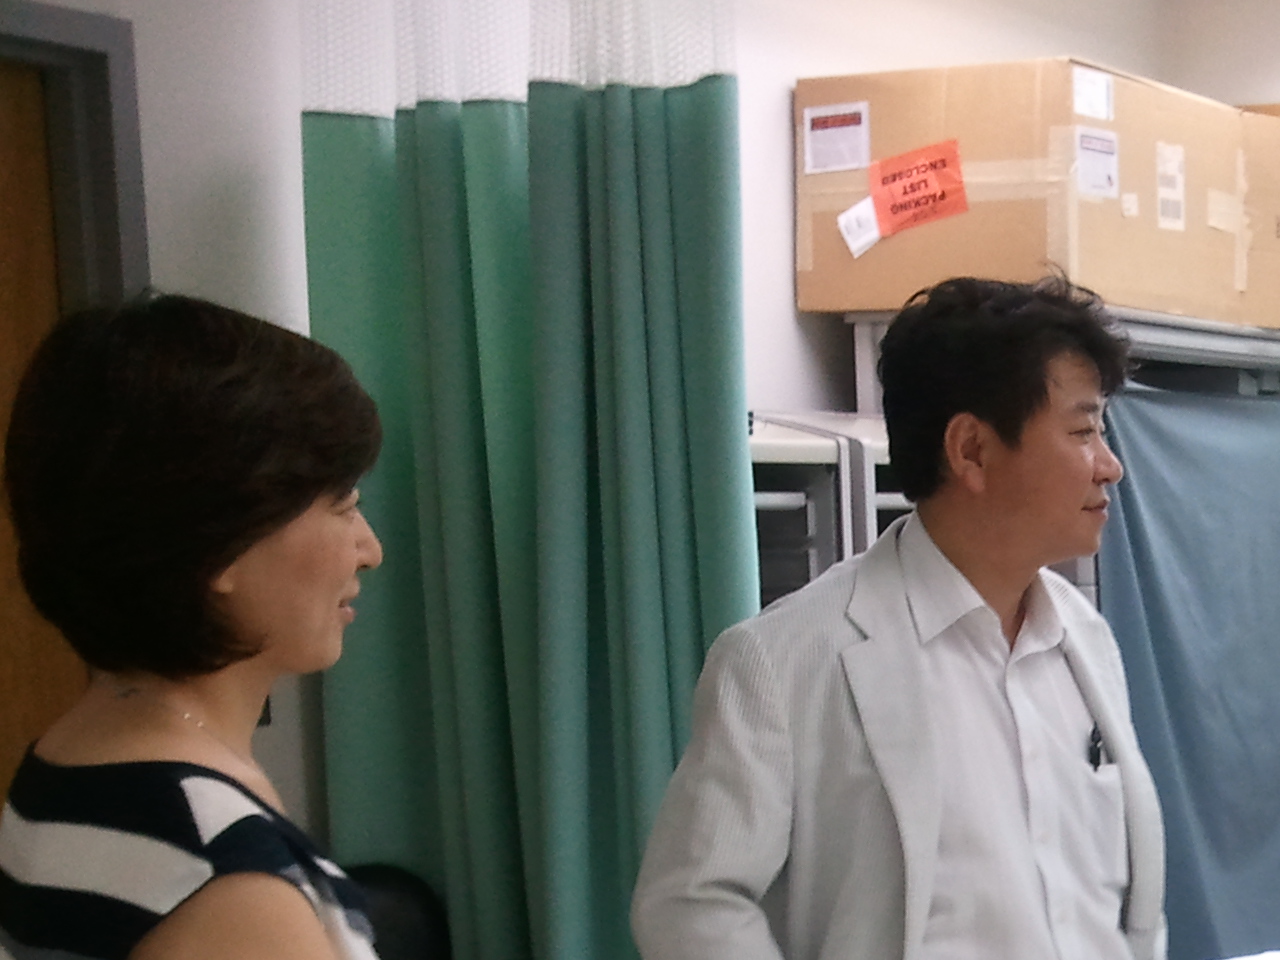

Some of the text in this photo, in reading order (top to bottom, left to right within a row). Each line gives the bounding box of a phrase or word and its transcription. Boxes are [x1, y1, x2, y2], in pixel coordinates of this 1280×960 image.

[881, 158, 947, 185] ENCLOSED
[902, 179, 928, 195] LIST
[890, 190, 946, 214] PACKING
